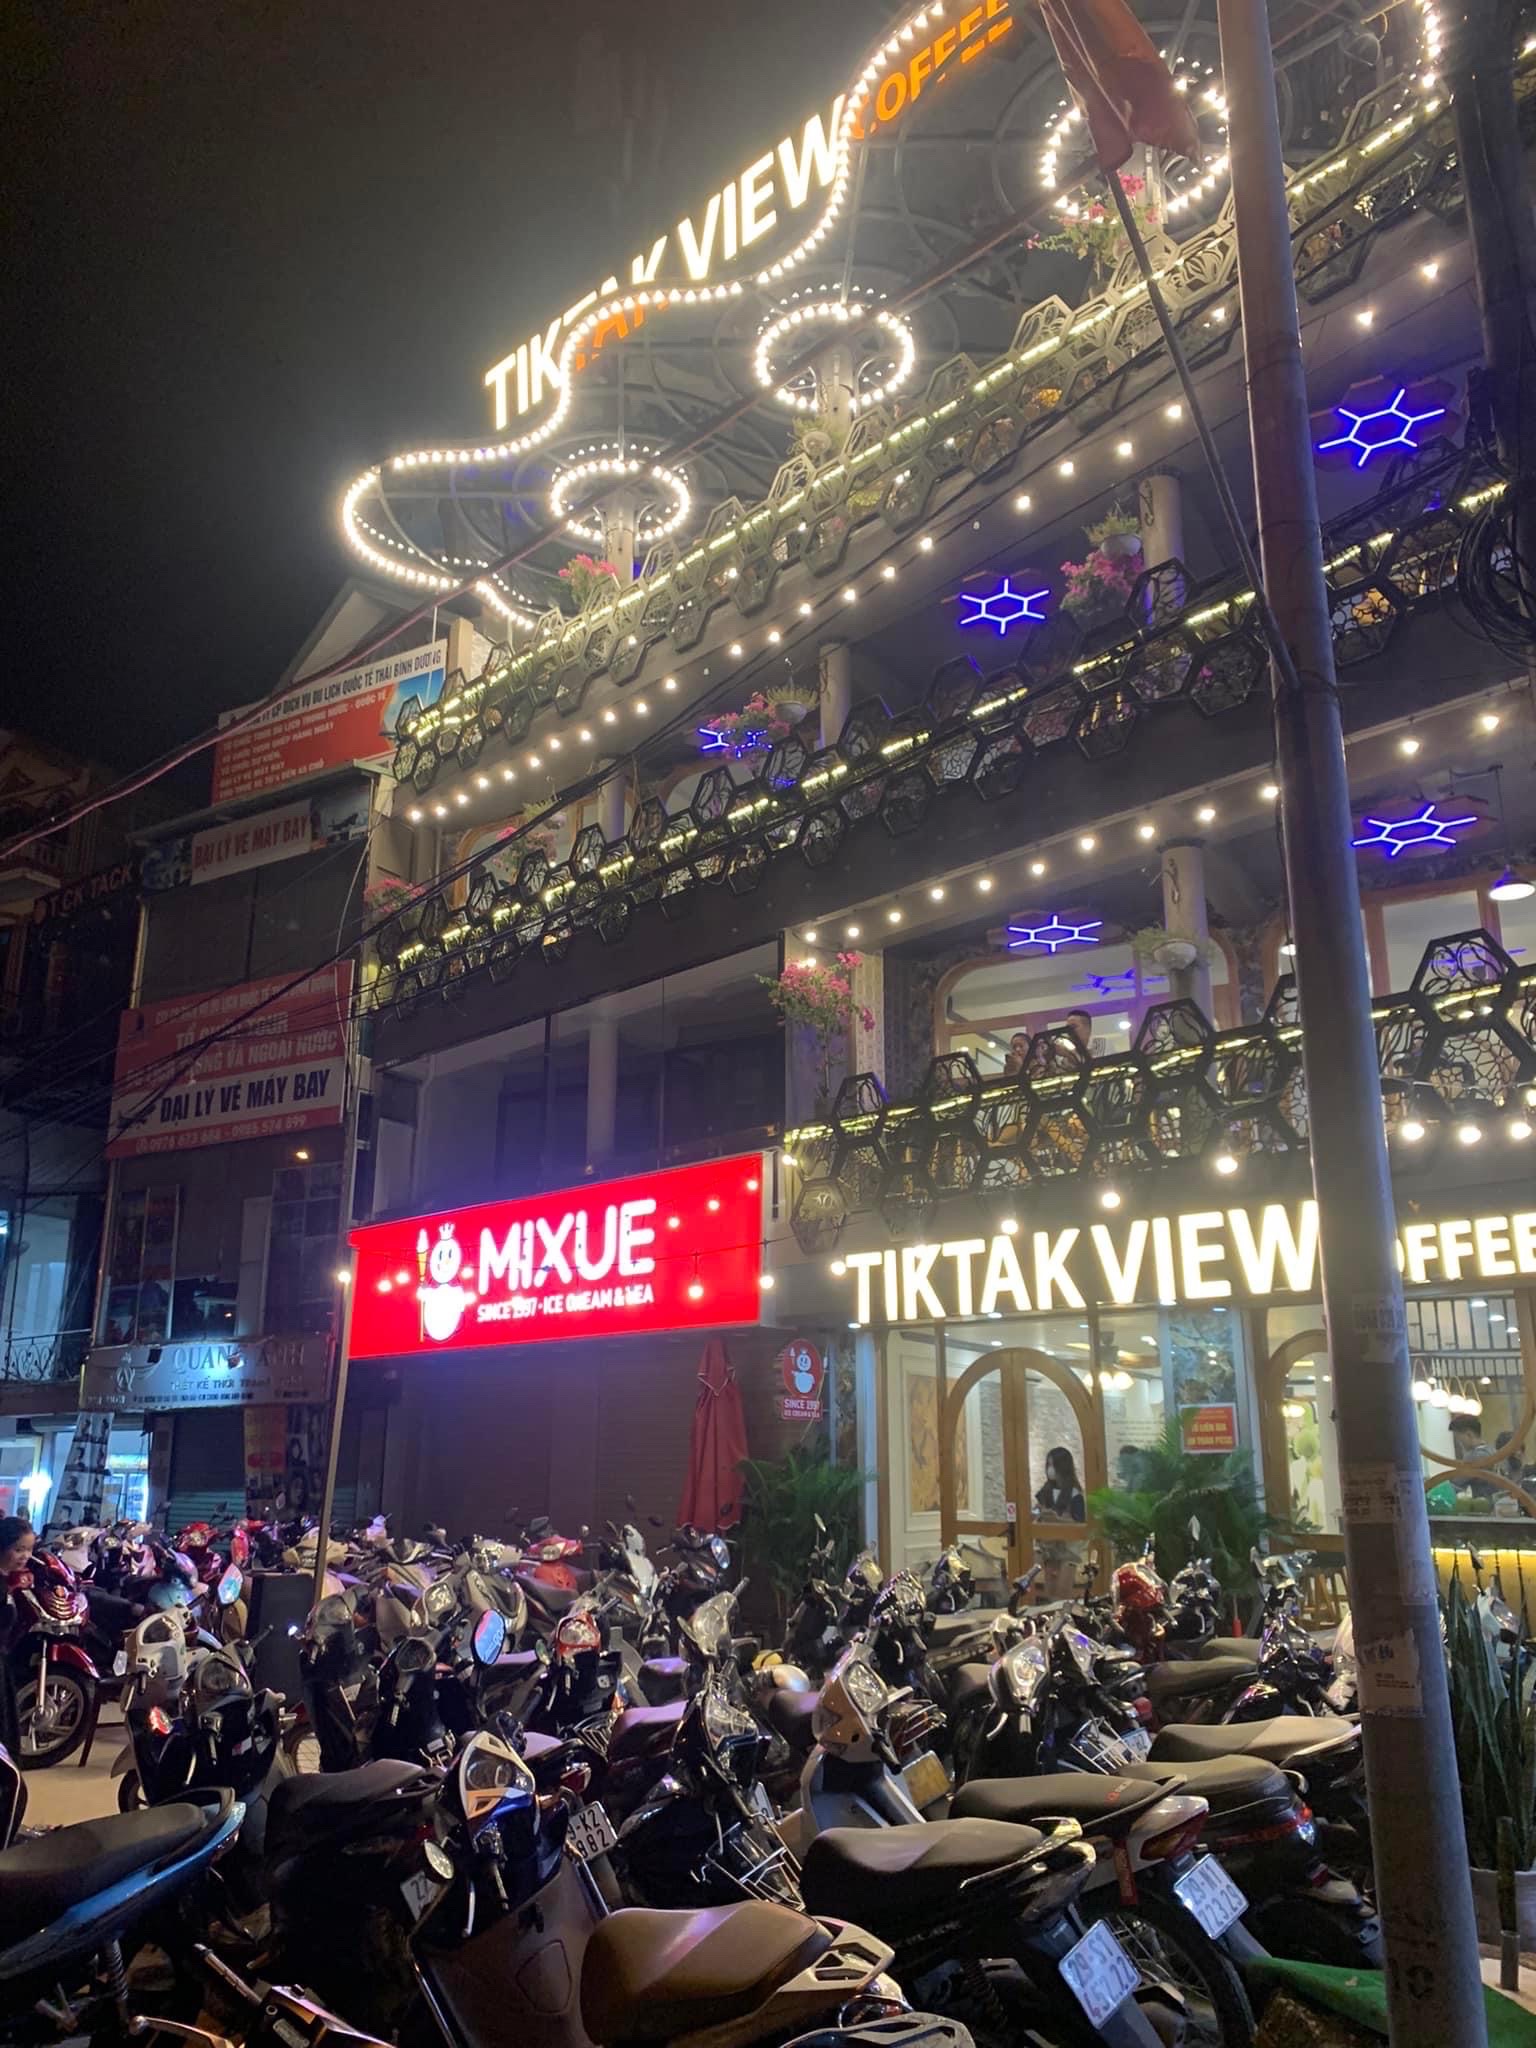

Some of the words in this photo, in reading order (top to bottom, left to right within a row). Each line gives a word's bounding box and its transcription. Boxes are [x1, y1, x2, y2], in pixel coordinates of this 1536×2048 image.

[677, 92, 847, 282] VIEW
[160, 1093, 190, 1126] ĐẠI
[194, 1084, 216, 1118] LÝ
[246, 1073, 288, 1109] MÁY
[293, 1069, 331, 1101] BAY
[478, 1197, 657, 1295] MIXUE
[845, 1228, 1087, 1325] TIKTAK
[1090, 1199, 1320, 1306] VIEW
[476, 1301, 512, 1323] SINCE
[542, 1294, 564, 1315] ICE
[567, 1808, 600, 1840] 9-K2
